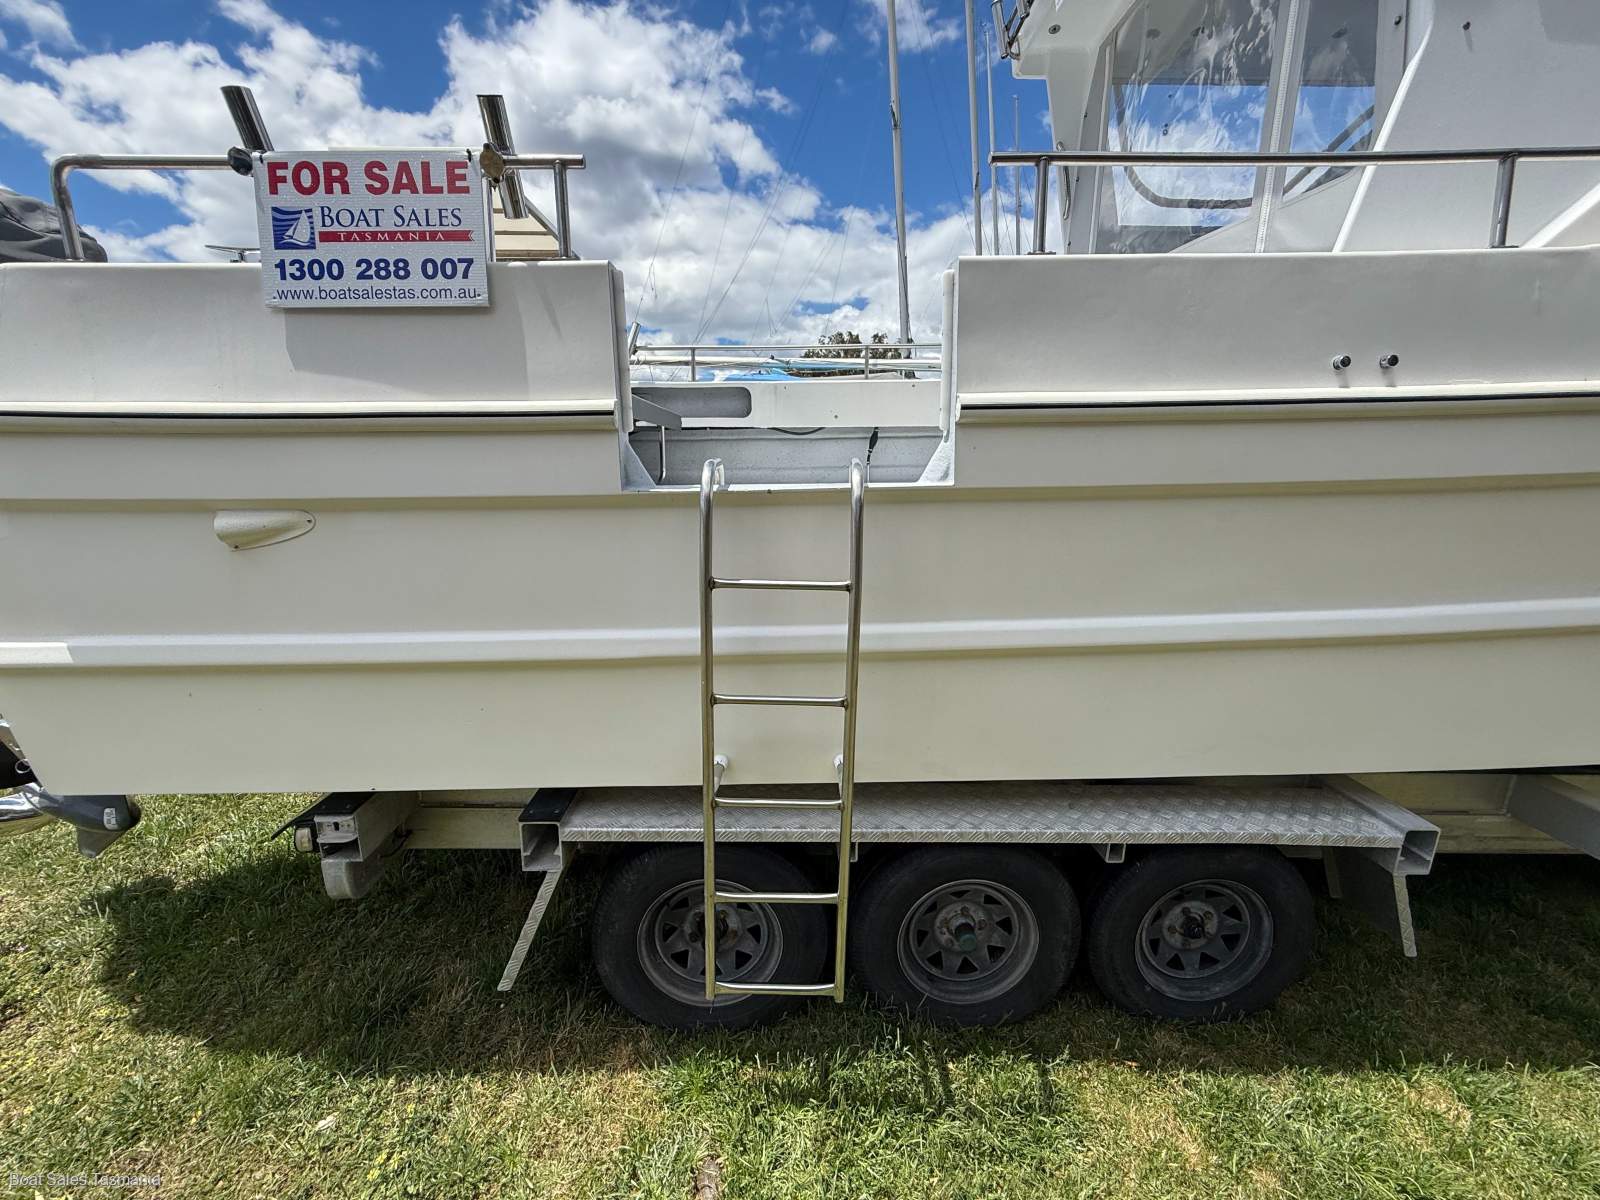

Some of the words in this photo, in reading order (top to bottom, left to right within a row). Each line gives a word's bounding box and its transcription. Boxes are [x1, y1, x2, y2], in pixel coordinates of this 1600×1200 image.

[267, 161, 351, 196] FOR
[364, 161, 470, 195] SALE
[319, 206, 384, 228] BOAT
[393, 205, 462, 227] SALES
[337, 231, 445, 241] TASMANIA
[274, 259, 345, 281] 1300
[355, 258, 411, 280] 288
[421, 257, 475, 280] 007
[276, 286, 476, 300] www.boatsalestas.com.au
